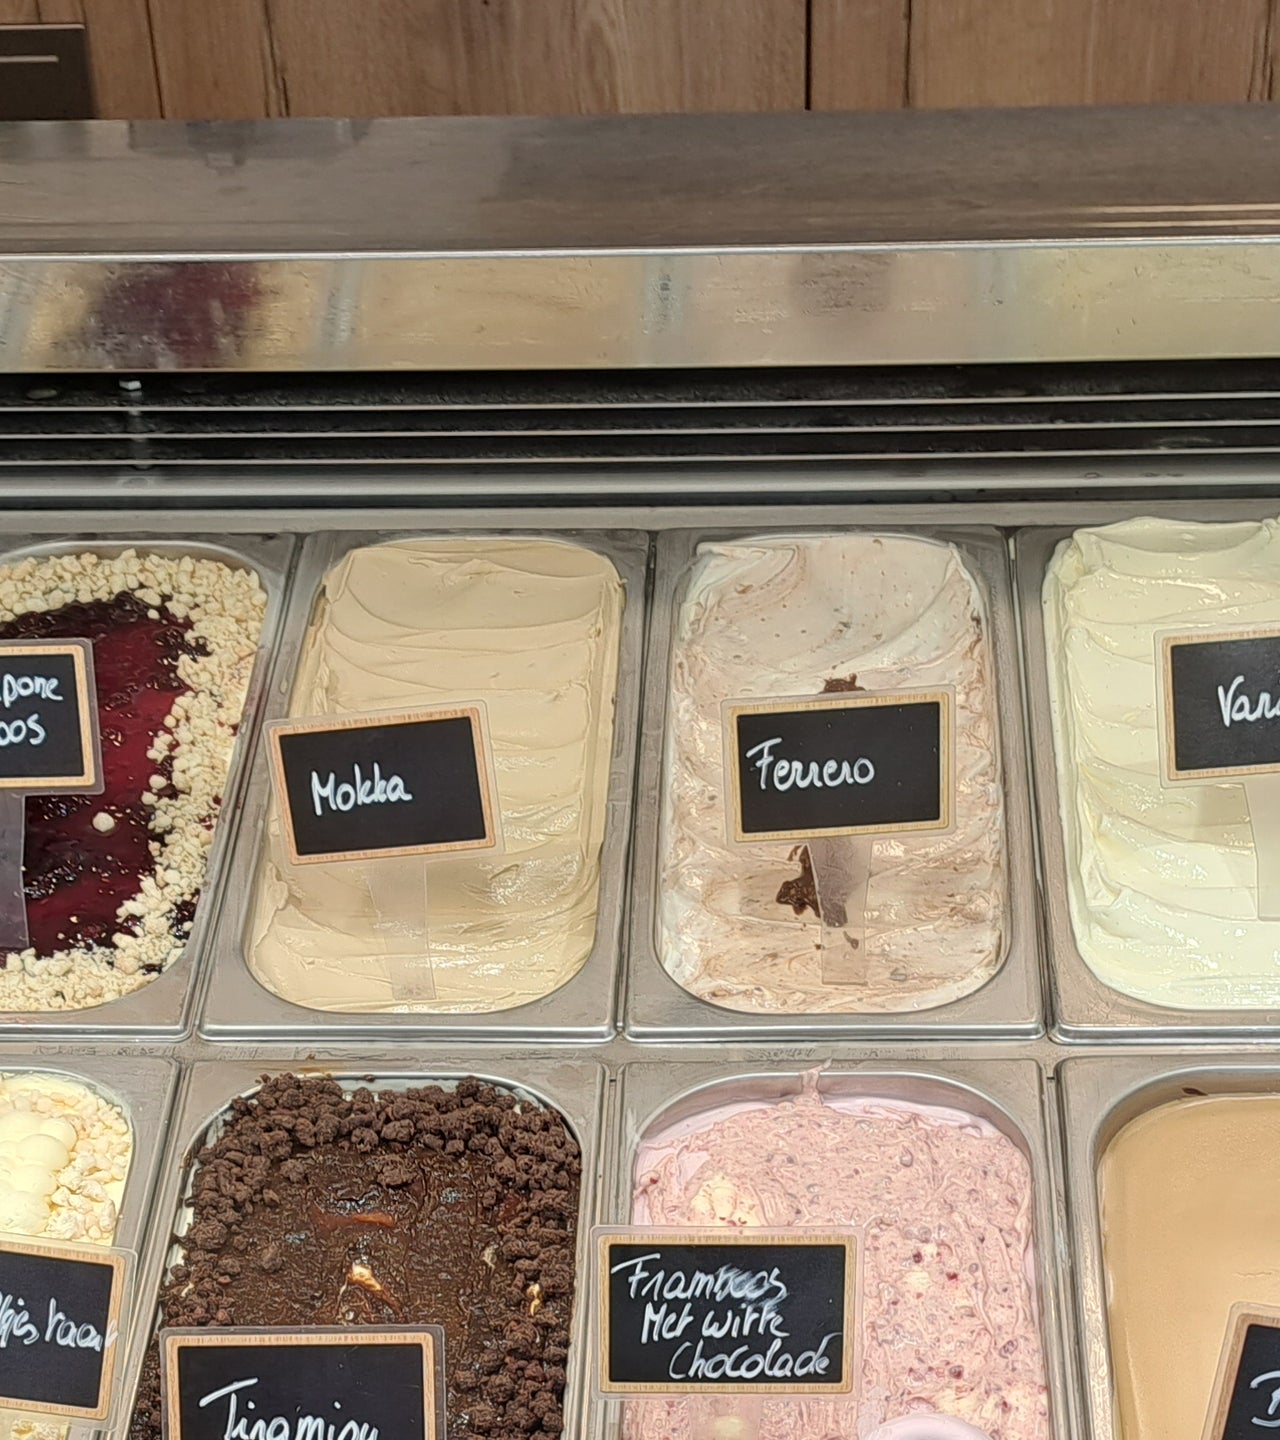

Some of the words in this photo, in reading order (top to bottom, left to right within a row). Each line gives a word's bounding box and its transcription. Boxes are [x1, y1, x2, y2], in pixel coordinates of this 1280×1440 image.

[311, 761, 414, 816] Mokka
[745, 736, 876, 792] Ferrero
[641, 1301, 694, 1344] Met
